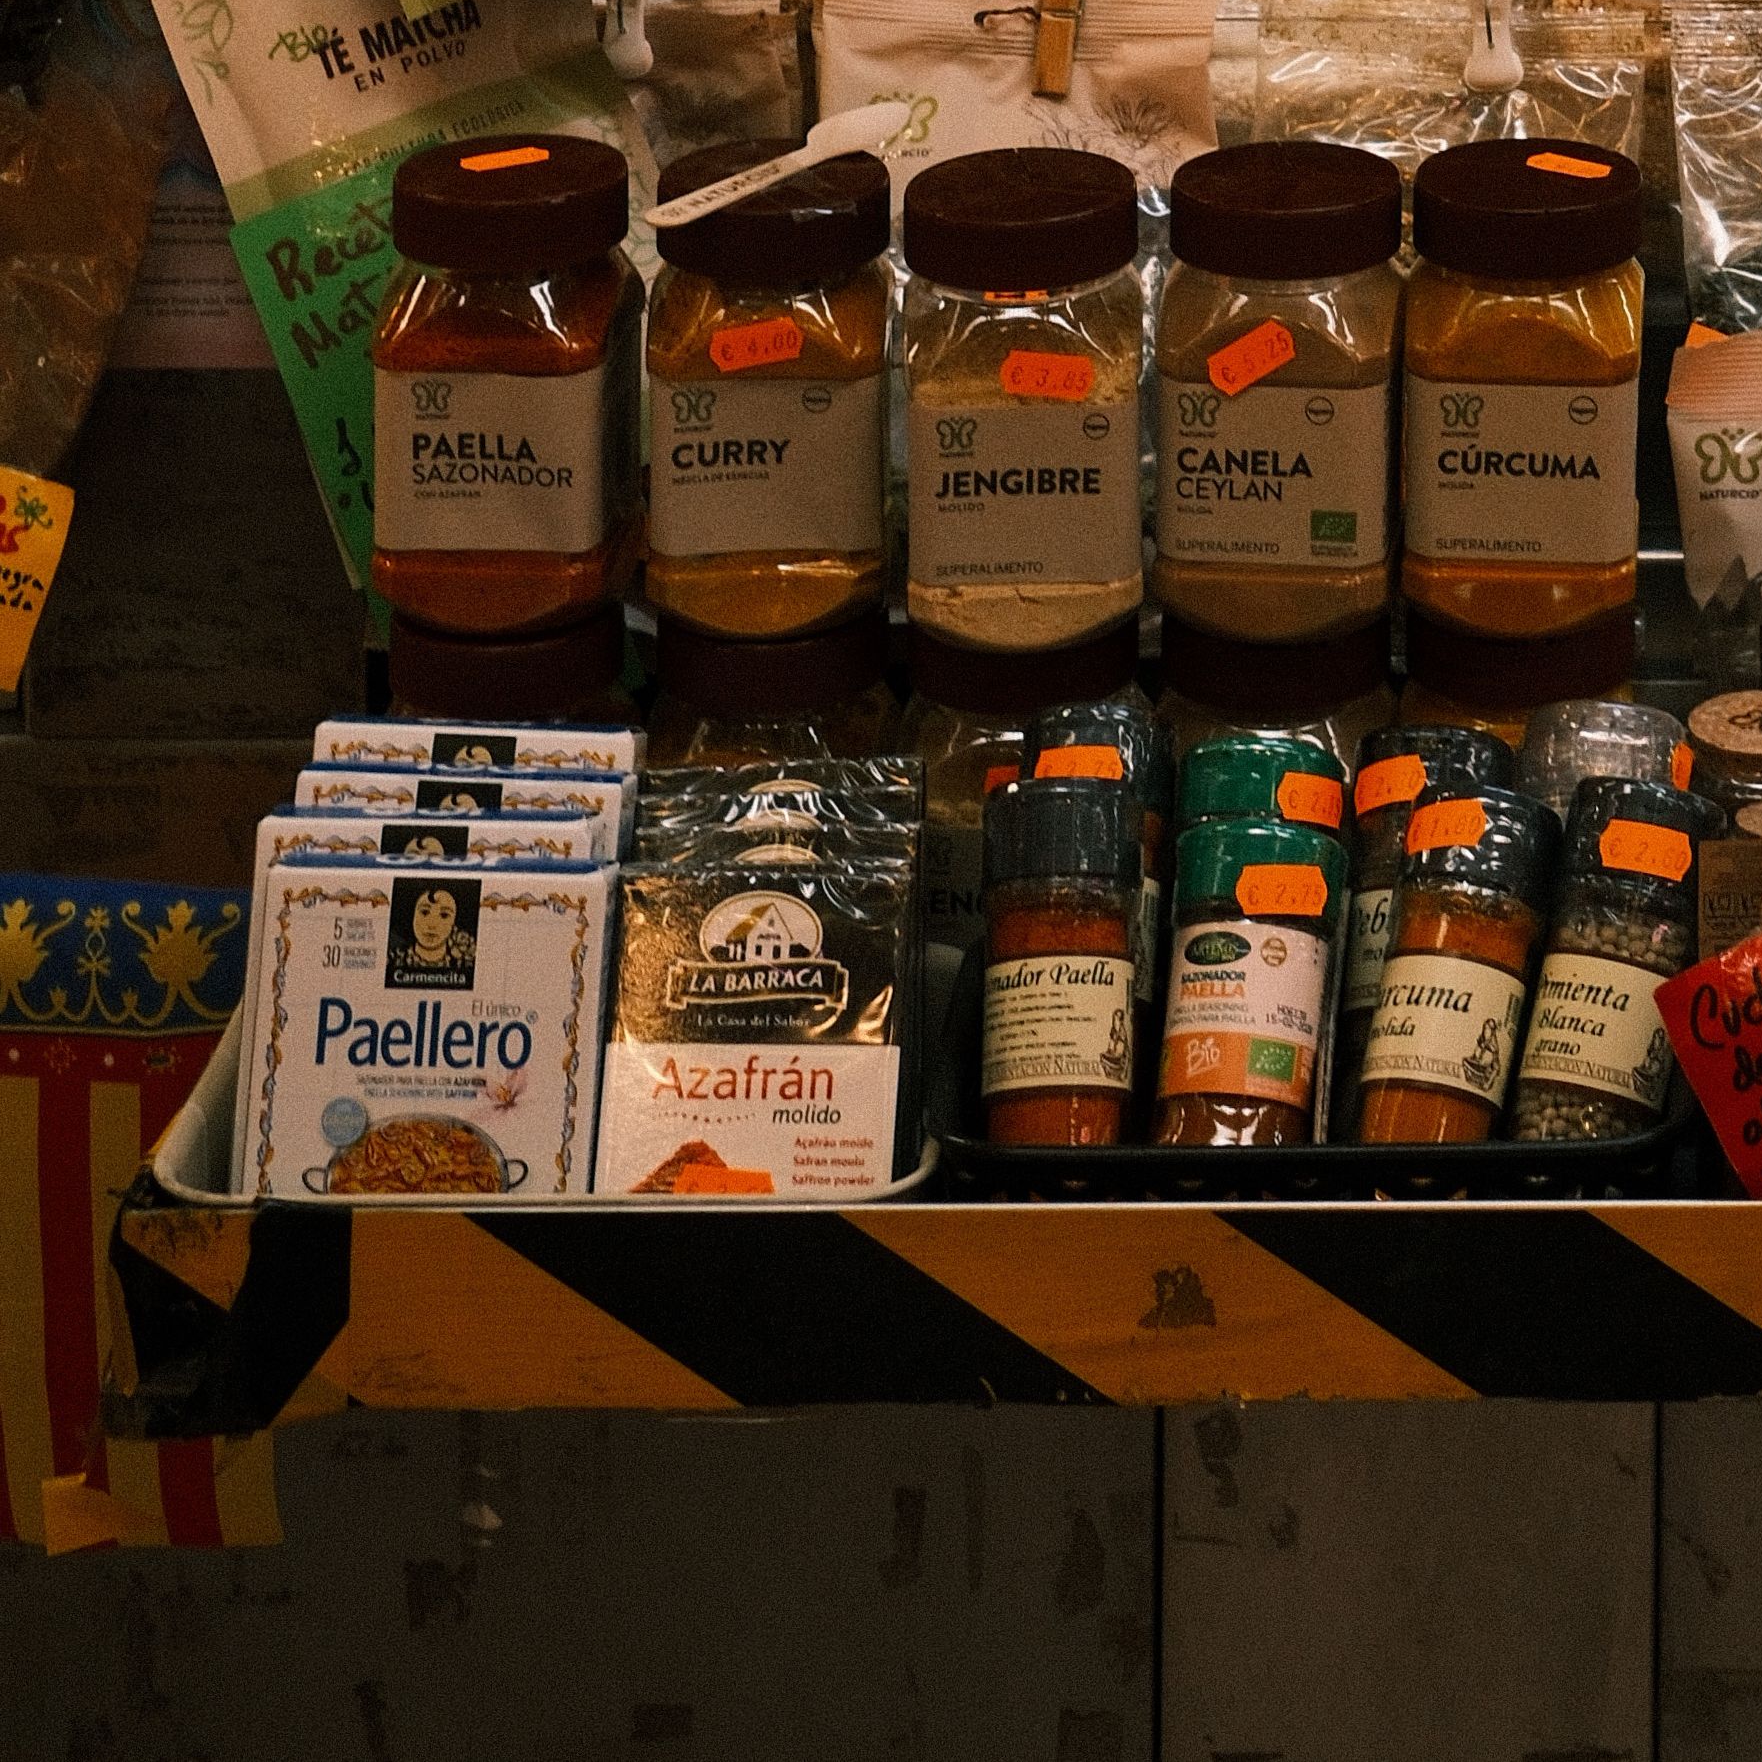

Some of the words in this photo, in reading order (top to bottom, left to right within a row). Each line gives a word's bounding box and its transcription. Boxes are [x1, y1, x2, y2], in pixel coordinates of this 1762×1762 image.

[353, 66, 386, 94] EN
[400, 39, 467, 77] POLVO
[411, 432, 539, 465] PAELLA
[670, 438, 792, 472] CURRY
[1176, 447, 1313, 479] CANELA
[1436, 443, 1602, 480] CÚRCUMA
[411, 462, 574, 490] SAZONADOR
[935, 466, 1101, 499] JENGIBRE
[1175, 477, 1284, 503] CEYLAN
[1174, 538, 1281, 555] SUPERALIMENTO
[1435, 537, 1543, 554] SUPERALIMENTO
[393, 969, 467, 986] Carmencita
[688, 972, 718, 994] LA
[724, 967, 825, 992] BARRACA
[1050, 960, 1115, 988] Paella
[314, 996, 534, 1071] Paellero
[1537, 1006, 1606, 1038] Blanca
[652, 1053, 835, 1103] Azafrán
[771, 1103, 843, 1127] molido
[833, 1174, 875, 1187] powder
